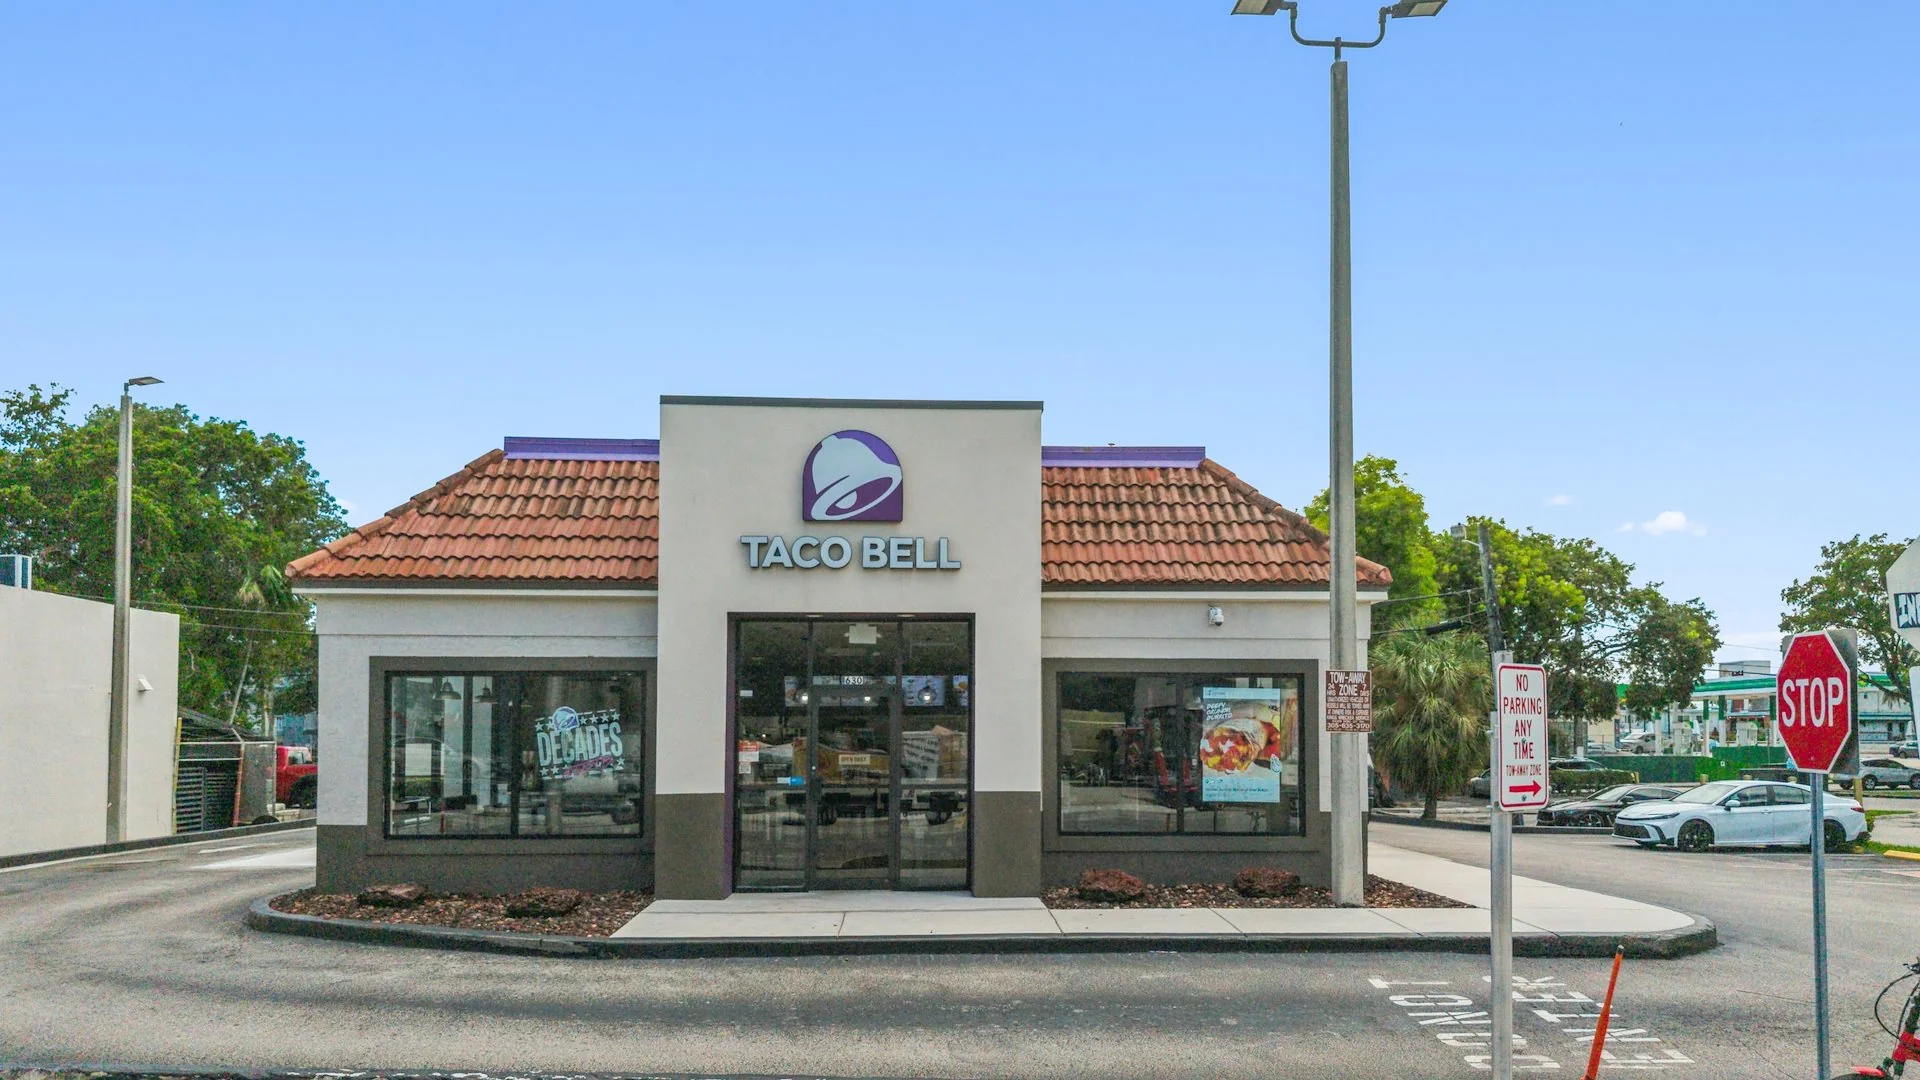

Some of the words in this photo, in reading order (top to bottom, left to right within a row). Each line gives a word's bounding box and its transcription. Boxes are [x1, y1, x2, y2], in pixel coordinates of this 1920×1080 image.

[740, 535, 852, 569] TACO
[861, 536, 962, 570] BELL
[845, 676, 863, 685] 630
[1330, 671, 1366, 684] TOW-AWAY
[1516, 674, 1529, 692] NO
[1338, 684, 1358, 696] ZONE
[1503, 697, 1542, 715] PARKING
[1781, 677, 1844, 728] STOP
[1514, 720, 1532, 737] ANY
[537, 722, 623, 766] DECADES
[1513, 742, 1534, 760] TIME
[1506, 764, 1529, 776] TOW-AWAY
[1530, 764, 1542, 776] ZONE
